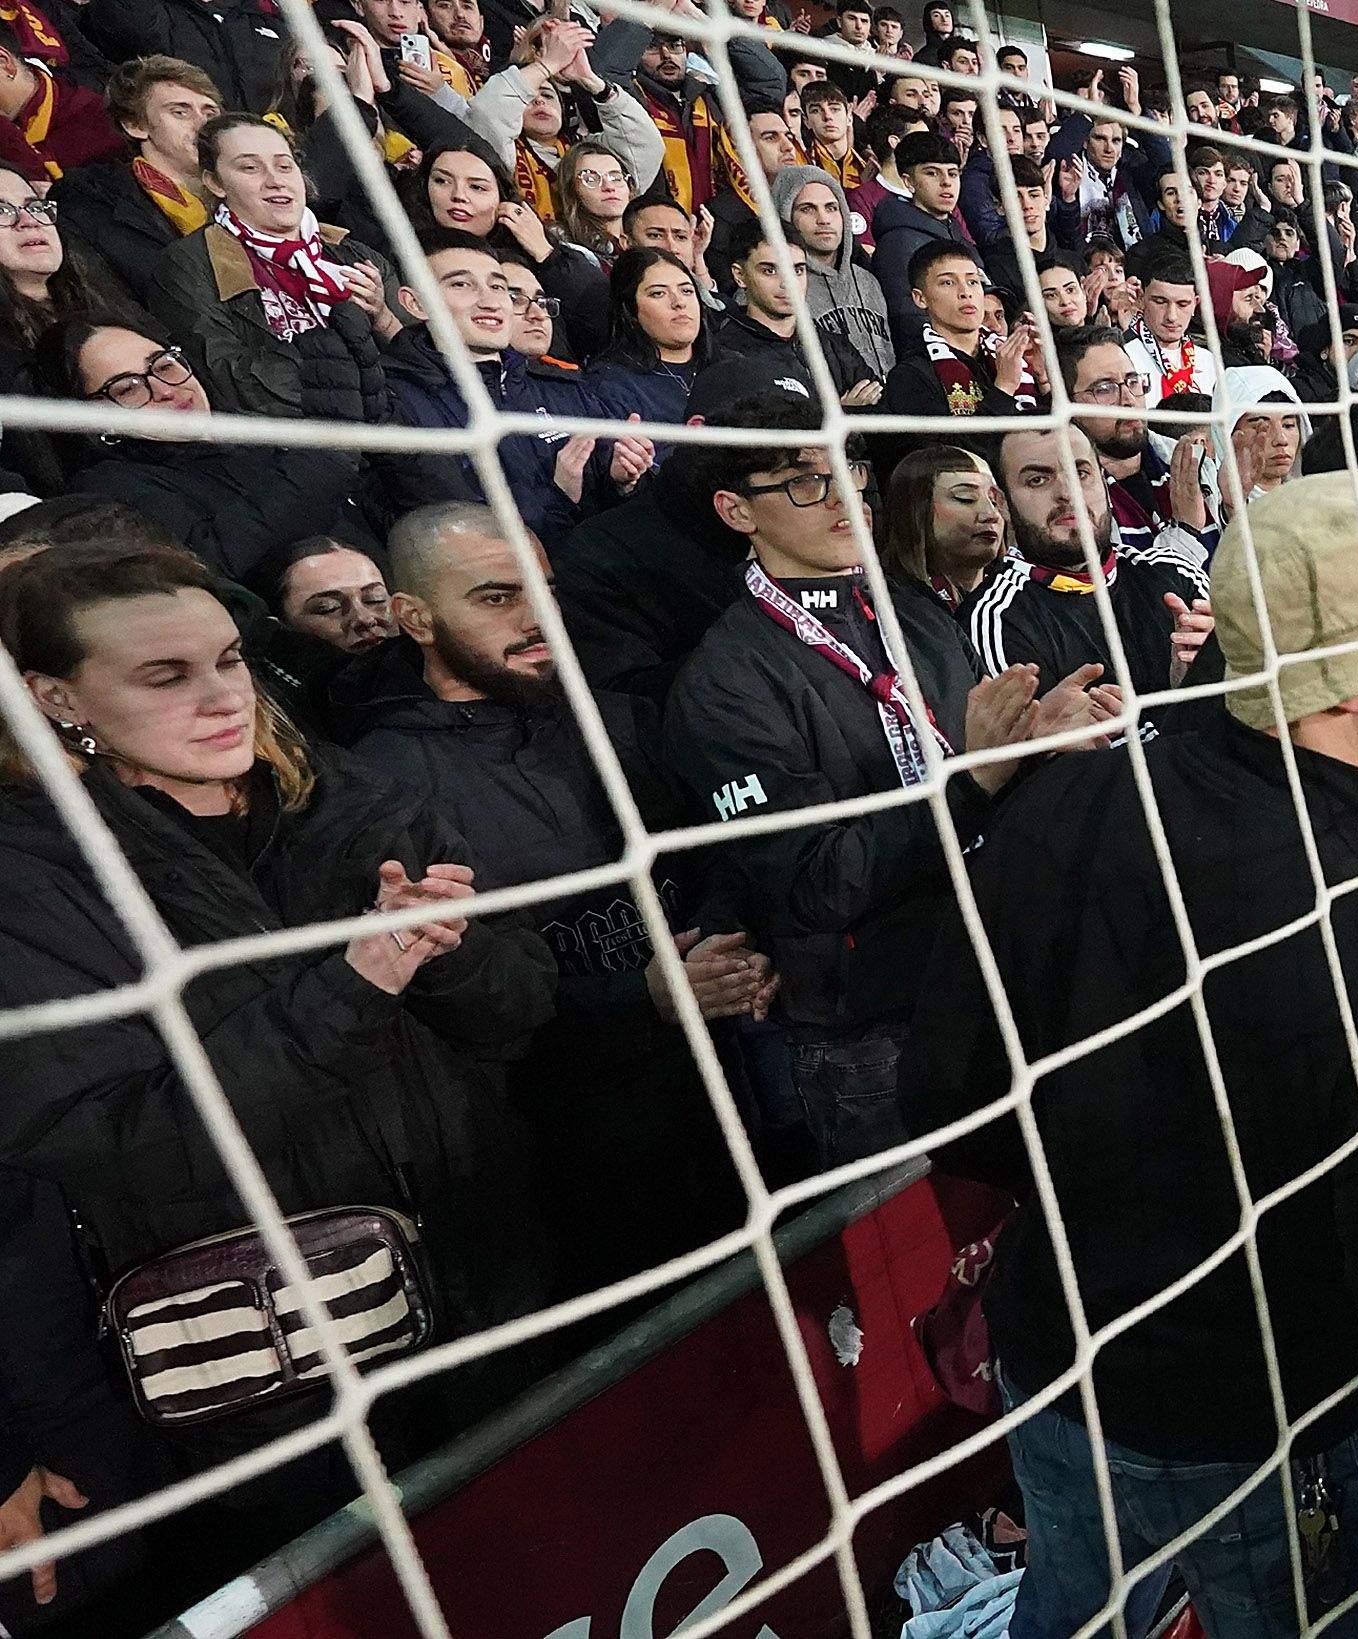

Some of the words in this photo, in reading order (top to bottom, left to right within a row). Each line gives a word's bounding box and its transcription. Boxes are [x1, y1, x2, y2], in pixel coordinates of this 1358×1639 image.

[814, 308, 846, 336] NEW
[849, 306, 890, 342] YORK
[801, 590, 838, 609] HH
[713, 773, 768, 822] HH
